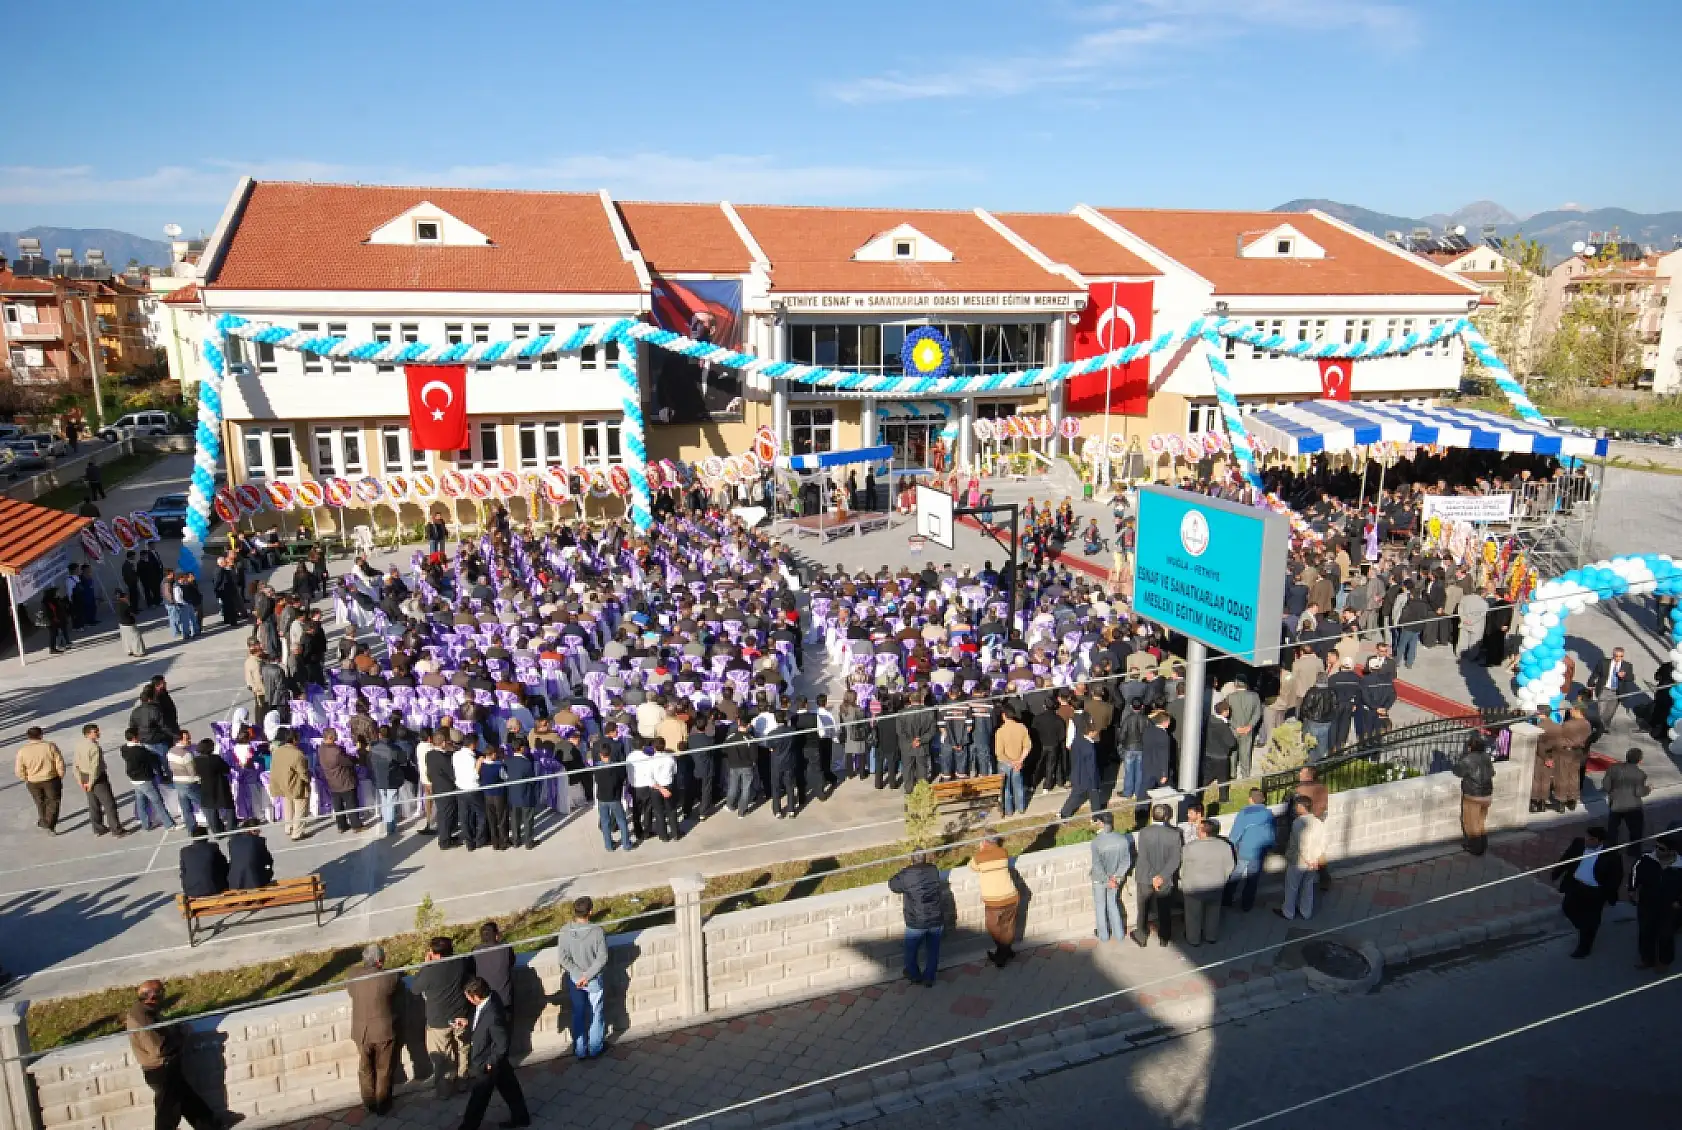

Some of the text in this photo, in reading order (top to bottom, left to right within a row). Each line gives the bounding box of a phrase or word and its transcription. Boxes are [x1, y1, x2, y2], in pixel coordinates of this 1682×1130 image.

[821, 295, 851, 307] ESNAF
[933, 295, 960, 306] ODASI
[963, 294, 999, 306] MESLEKİ
[1002, 294, 1031, 306] EĞİTİM
[1034, 294, 1070, 306] MERKEZİ
[1137, 566, 1253, 622] ESNAF VE SANATKARLAR ODASI
